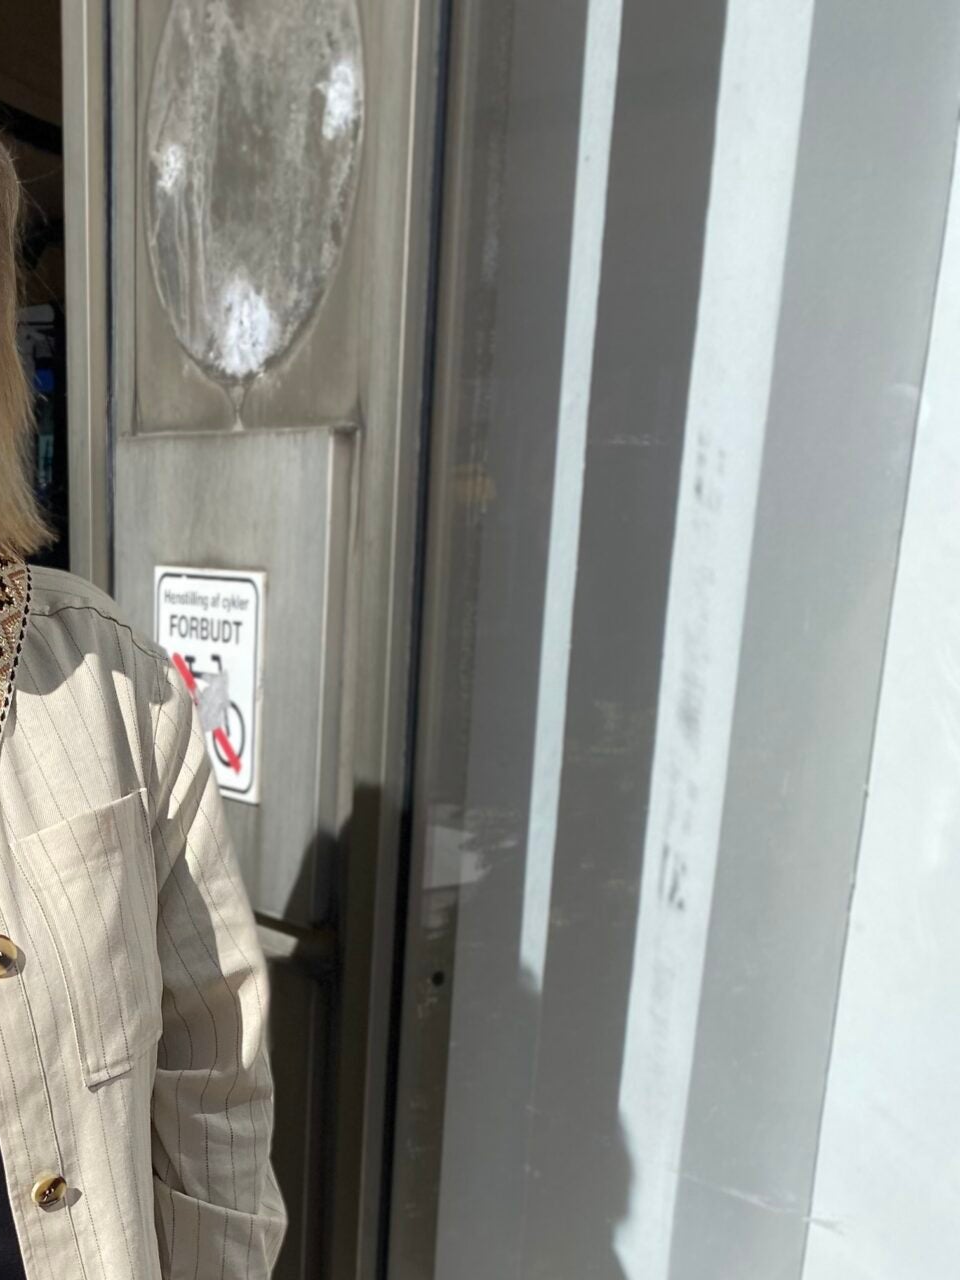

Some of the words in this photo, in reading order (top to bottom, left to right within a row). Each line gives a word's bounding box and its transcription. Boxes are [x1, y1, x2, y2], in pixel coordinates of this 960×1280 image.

[164, 589, 209, 611] Henstilling
[210, 592, 221, 608] af
[222, 594, 249, 612] cykler
[169, 614, 243, 645] FORBUDT
